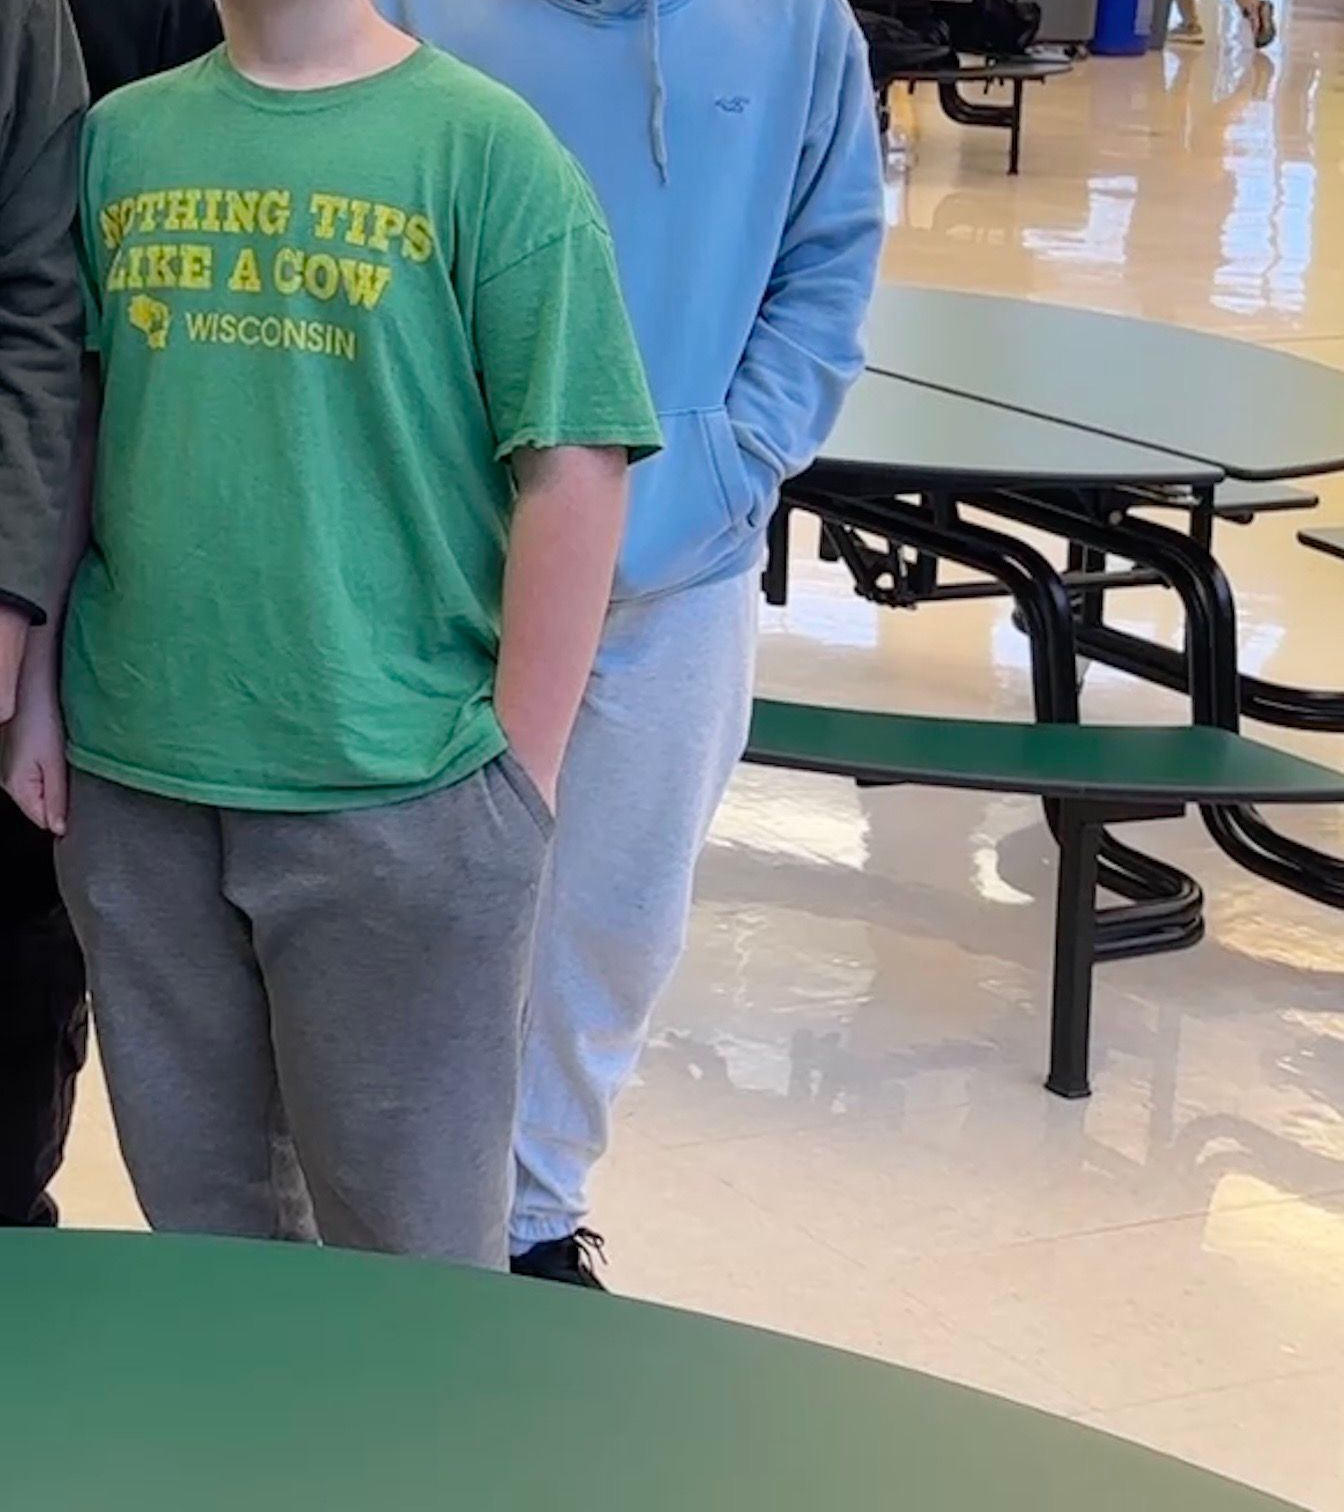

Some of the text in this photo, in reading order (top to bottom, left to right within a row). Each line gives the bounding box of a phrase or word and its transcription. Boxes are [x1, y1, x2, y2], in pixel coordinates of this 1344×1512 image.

[310, 193, 435, 263] TIPS
[227, 248, 262, 292] A
[273, 247, 393, 311] COW
[184, 310, 358, 360] WISCONSIN
